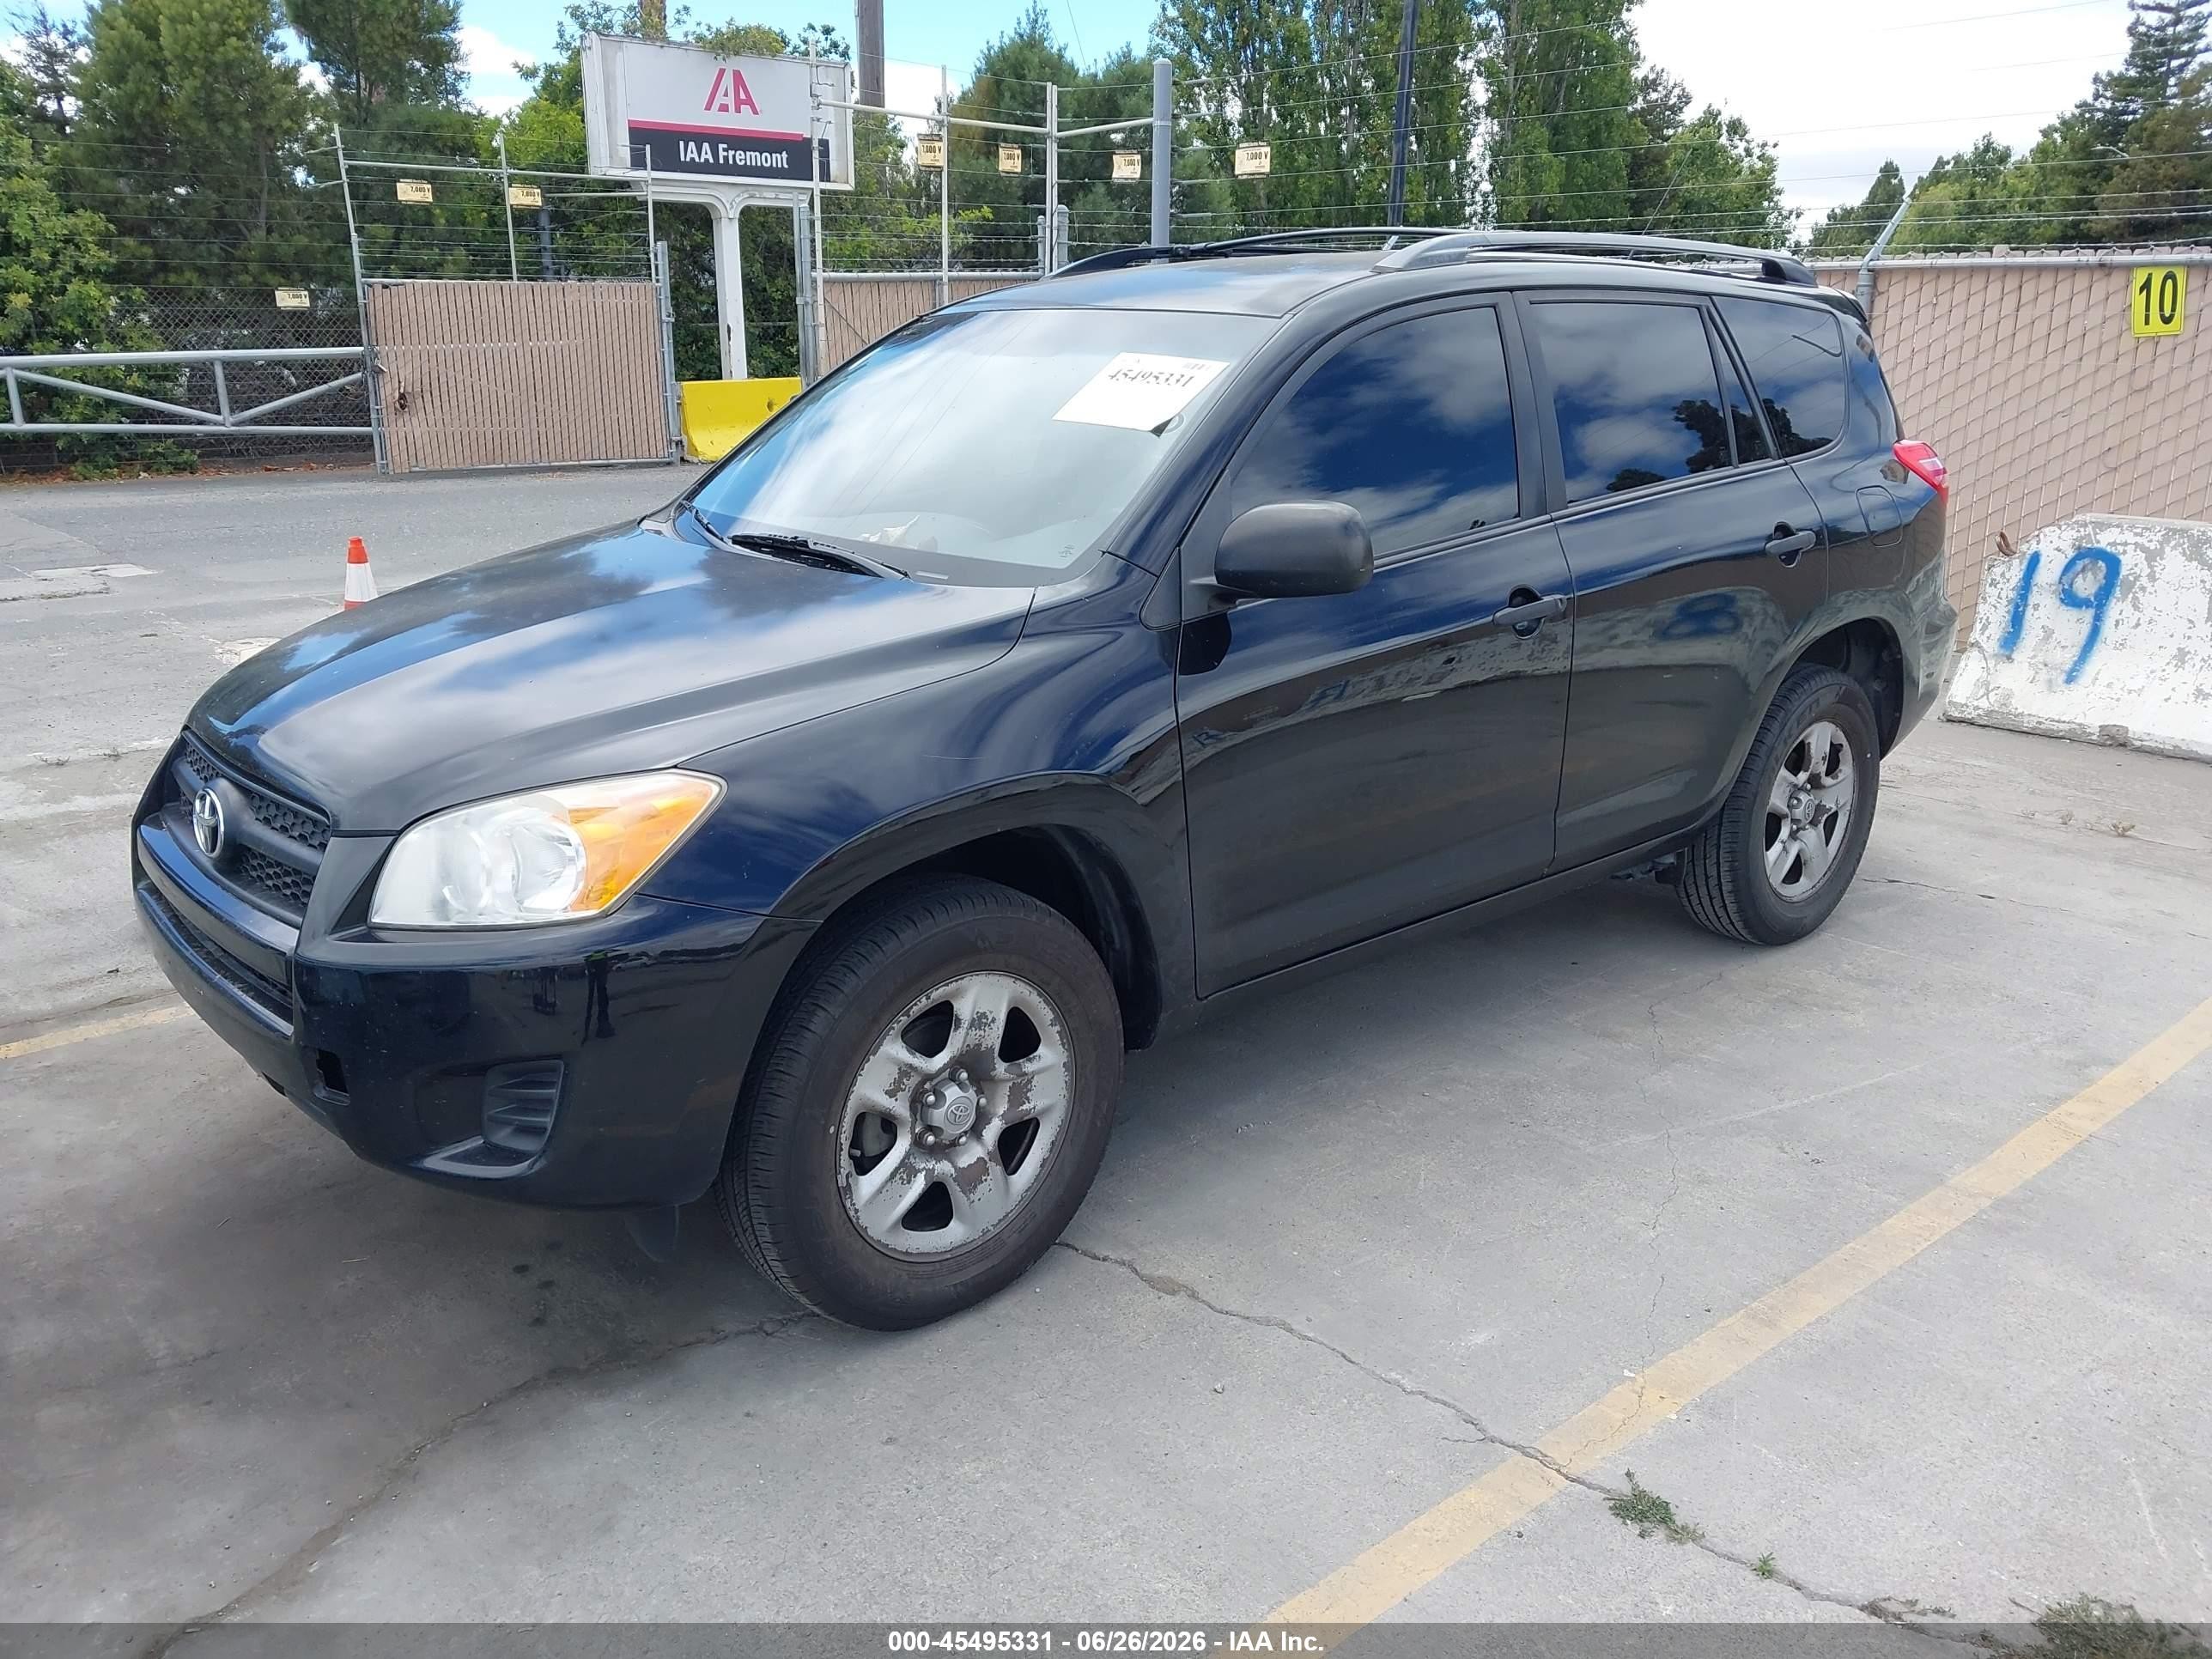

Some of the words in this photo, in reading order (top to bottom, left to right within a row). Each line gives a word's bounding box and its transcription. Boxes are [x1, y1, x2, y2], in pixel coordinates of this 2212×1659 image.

[679, 140, 714, 164] IAA
[718, 143, 789, 168] Fremont
[938, 146, 942, 155] V
[1246, 151, 1262, 161] 7,000
[1264, 150, 1269, 160] V
[1016, 153, 1020, 161] V
[1136, 158, 1140, 167] V
[2138, 270, 2179, 326] 10
[1998, 545, 2122, 685] 19
